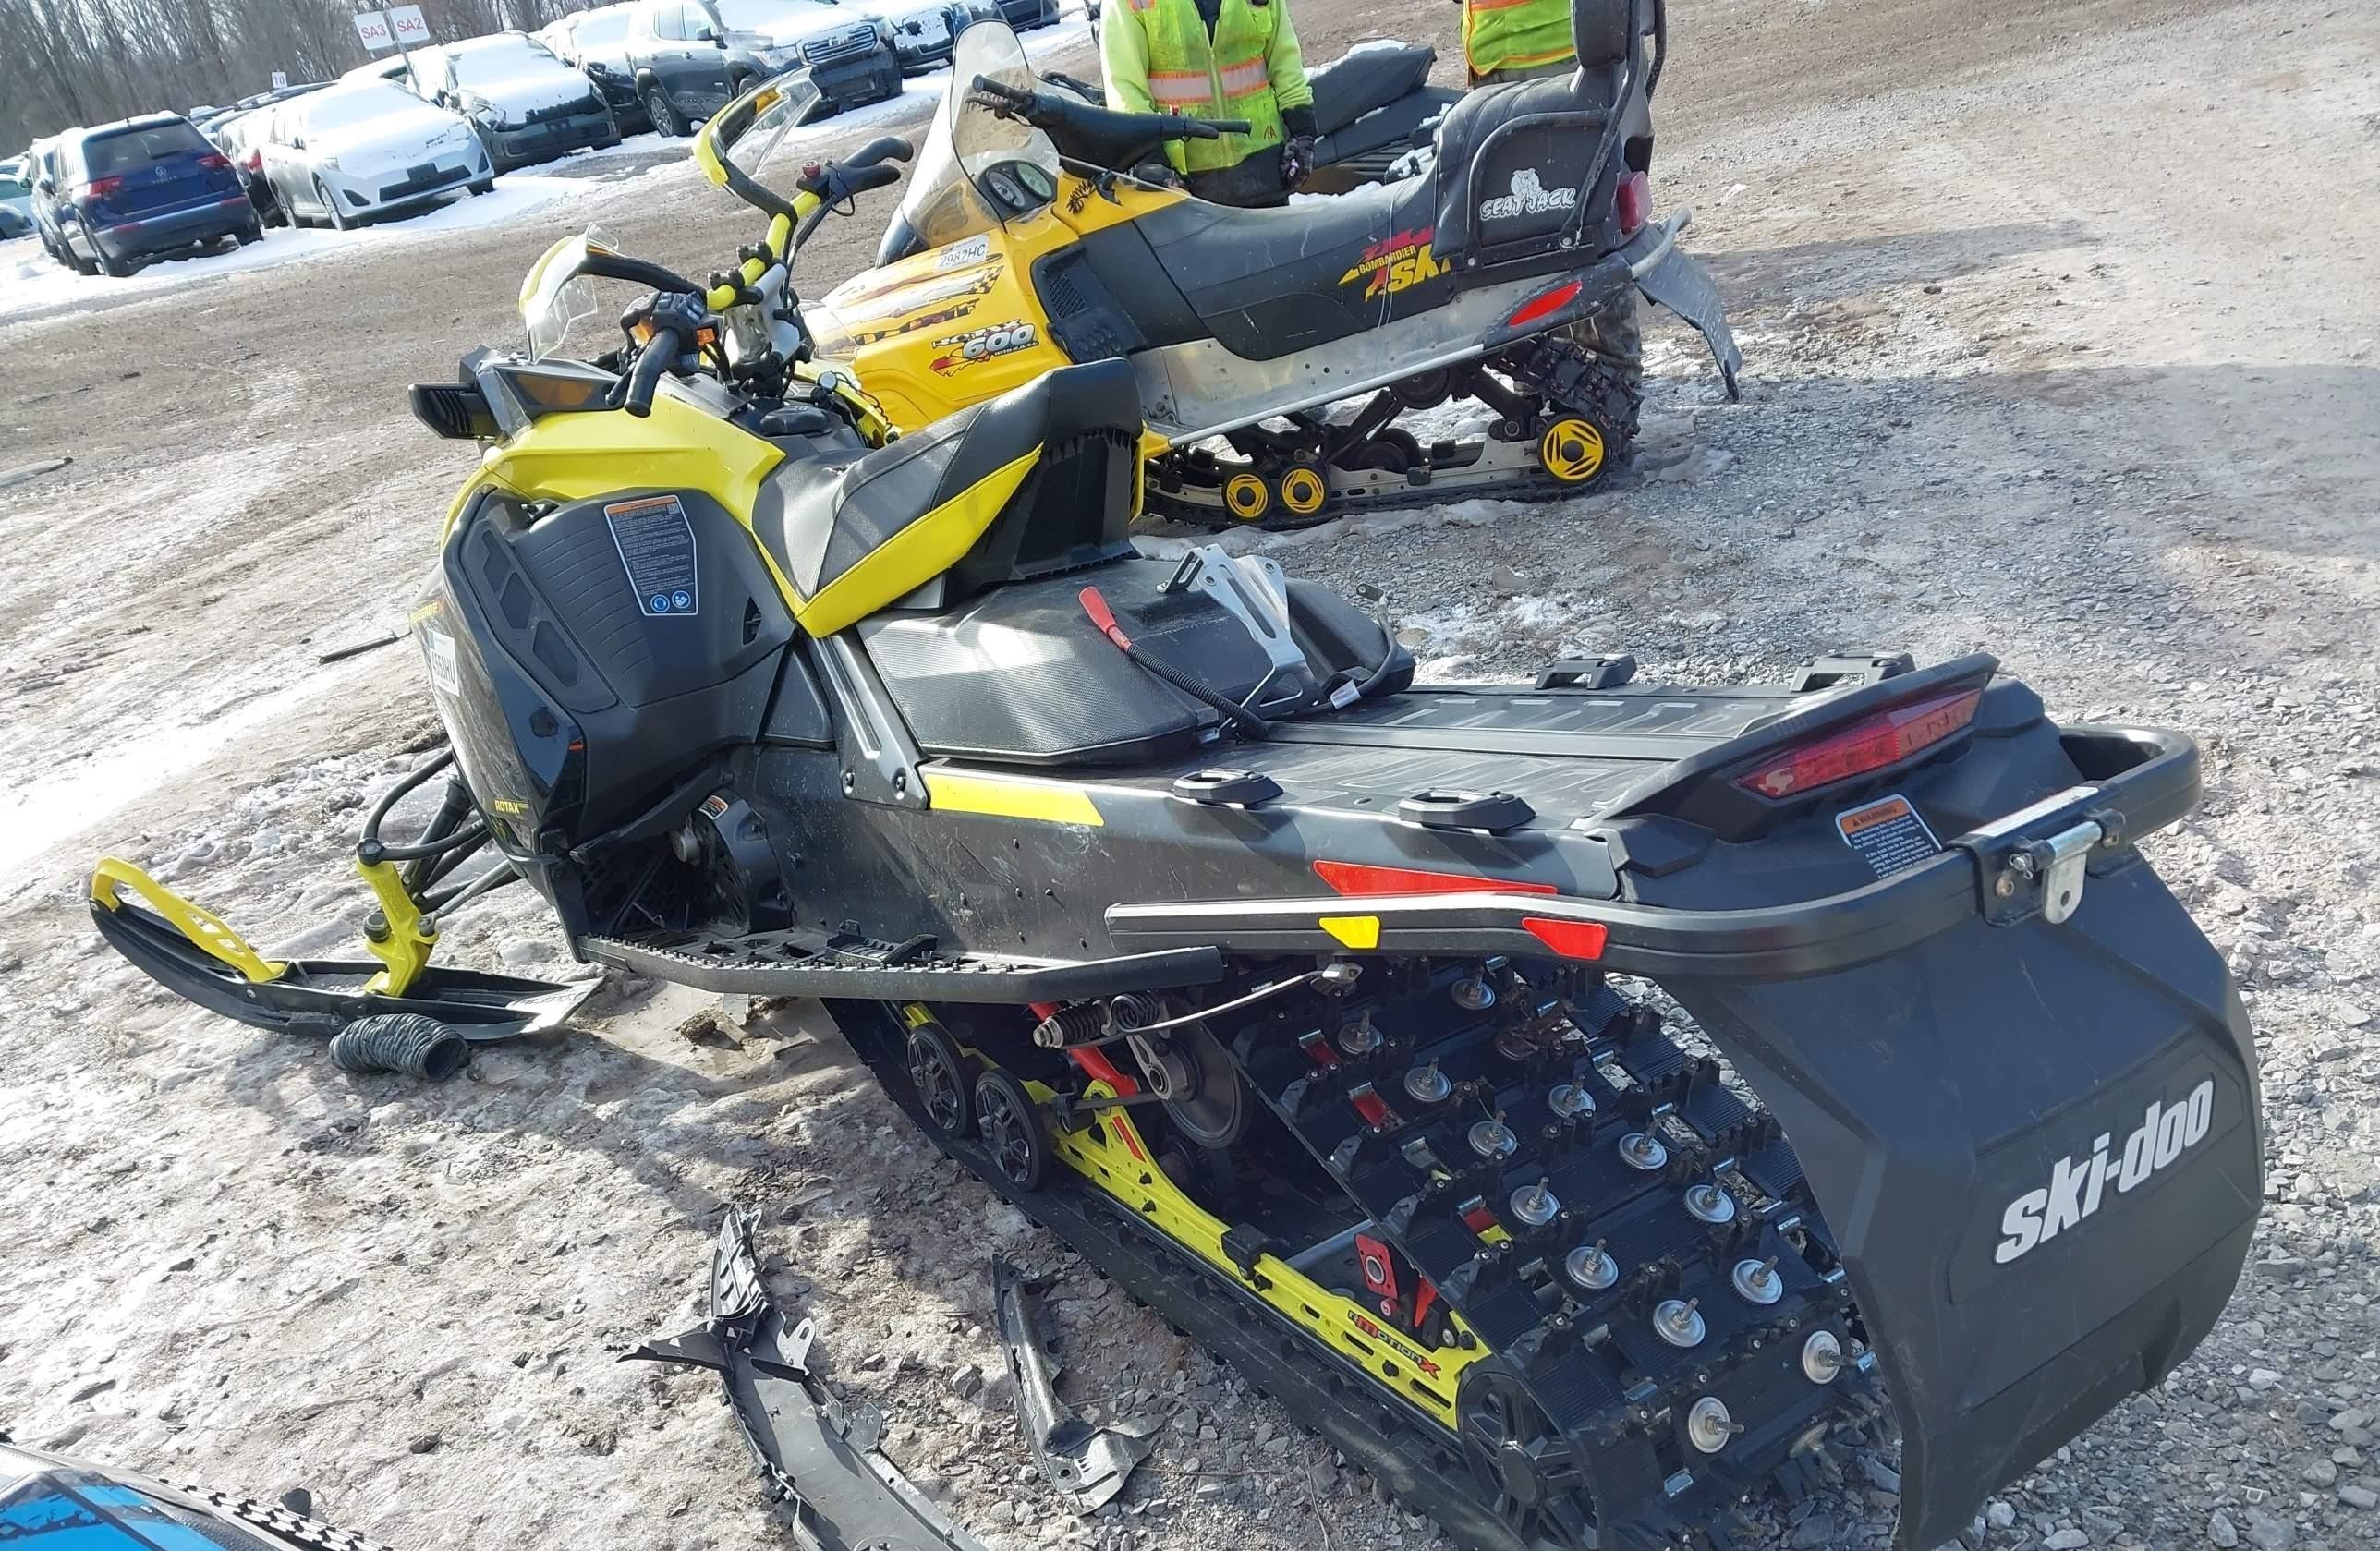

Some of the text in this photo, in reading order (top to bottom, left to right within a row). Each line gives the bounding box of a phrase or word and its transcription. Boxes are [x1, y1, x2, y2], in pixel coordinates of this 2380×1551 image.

[361, 24, 386, 38] SA3
[396, 17, 423, 32] SA2
[1480, 188, 1576, 221] SEAT JACK
[1358, 244, 1416, 274] BOMBARDIER
[1387, 243, 1451, 293] SK
[962, 323, 1035, 358] 600
[494, 799, 520, 814] ROTAX
[1995, 1080, 2214, 1264] ski-doo
